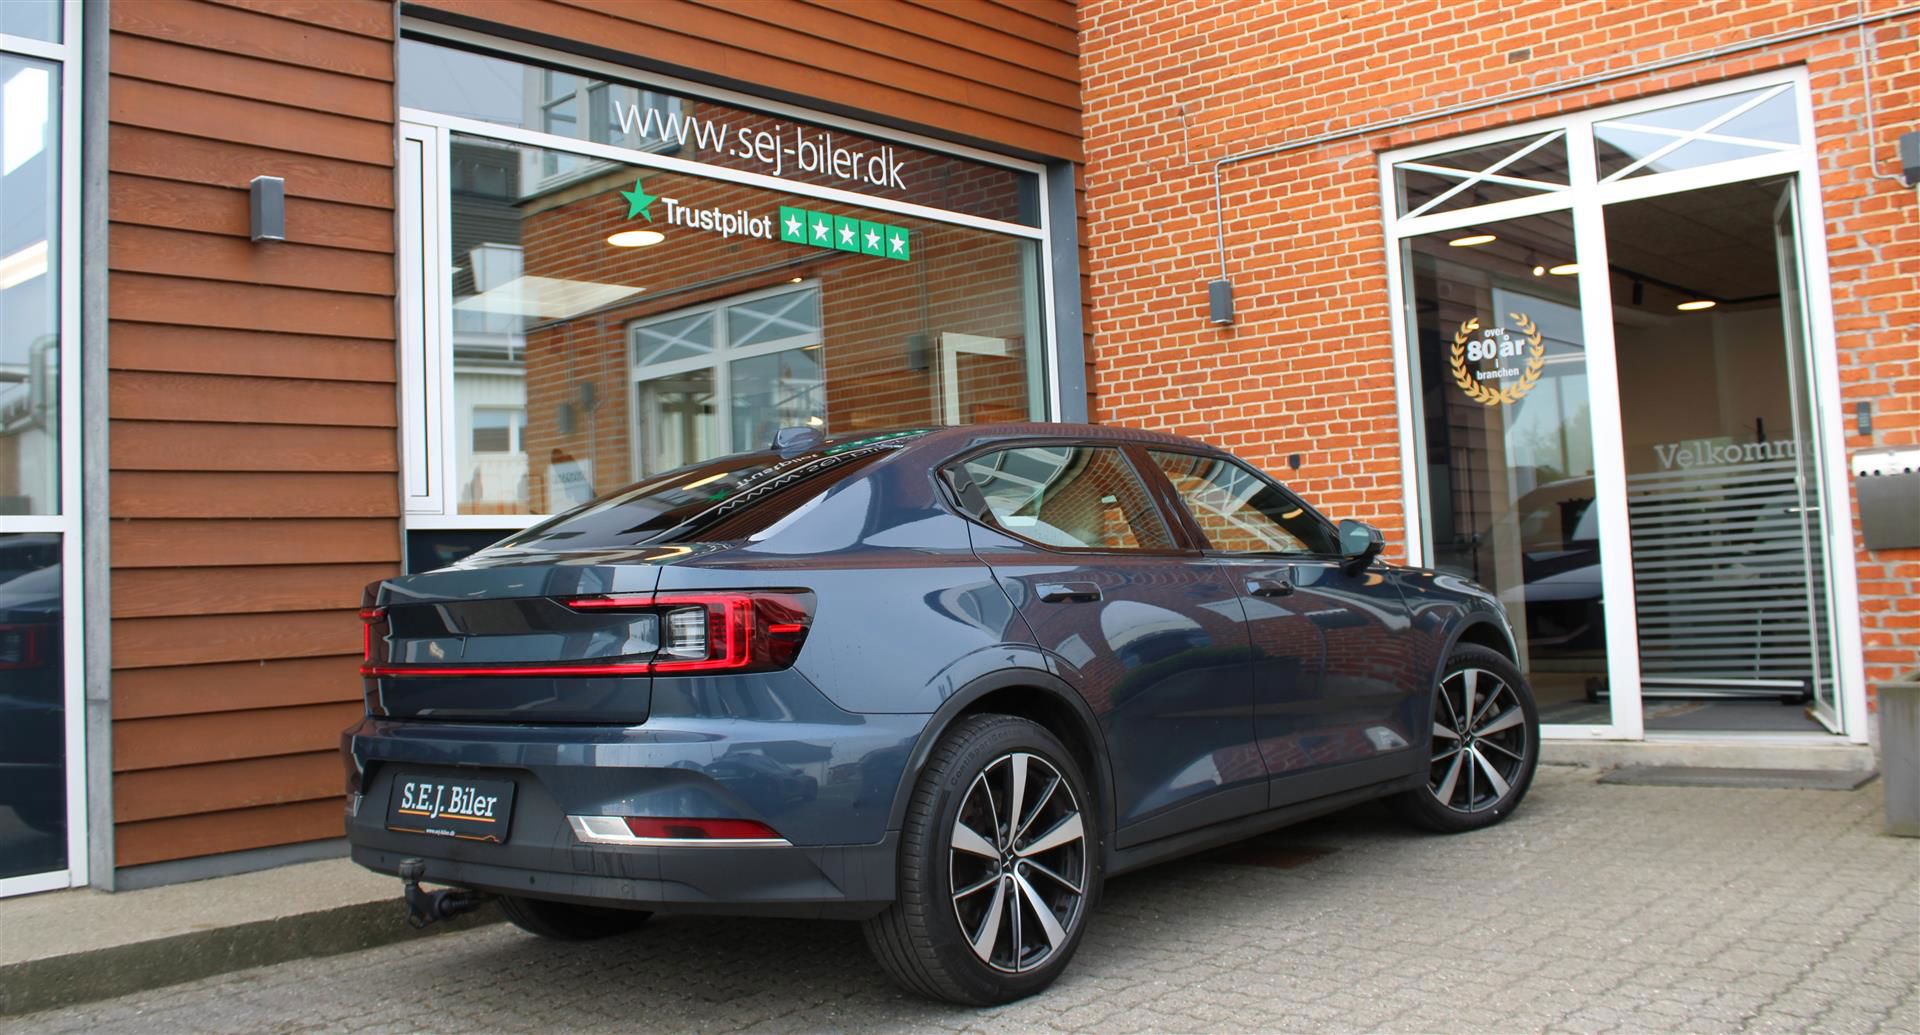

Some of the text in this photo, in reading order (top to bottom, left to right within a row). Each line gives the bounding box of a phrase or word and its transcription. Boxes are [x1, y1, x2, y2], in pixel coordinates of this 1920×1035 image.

[615, 100, 907, 191] www.sej-biler.dk
[661, 197, 773, 240] Trustpilot
[1467, 334, 1525, 361] 80 år
[1484, 327, 1505, 338] over
[1476, 367, 1520, 380] branchen
[401, 782, 497, 819] S.E.J. Biler
